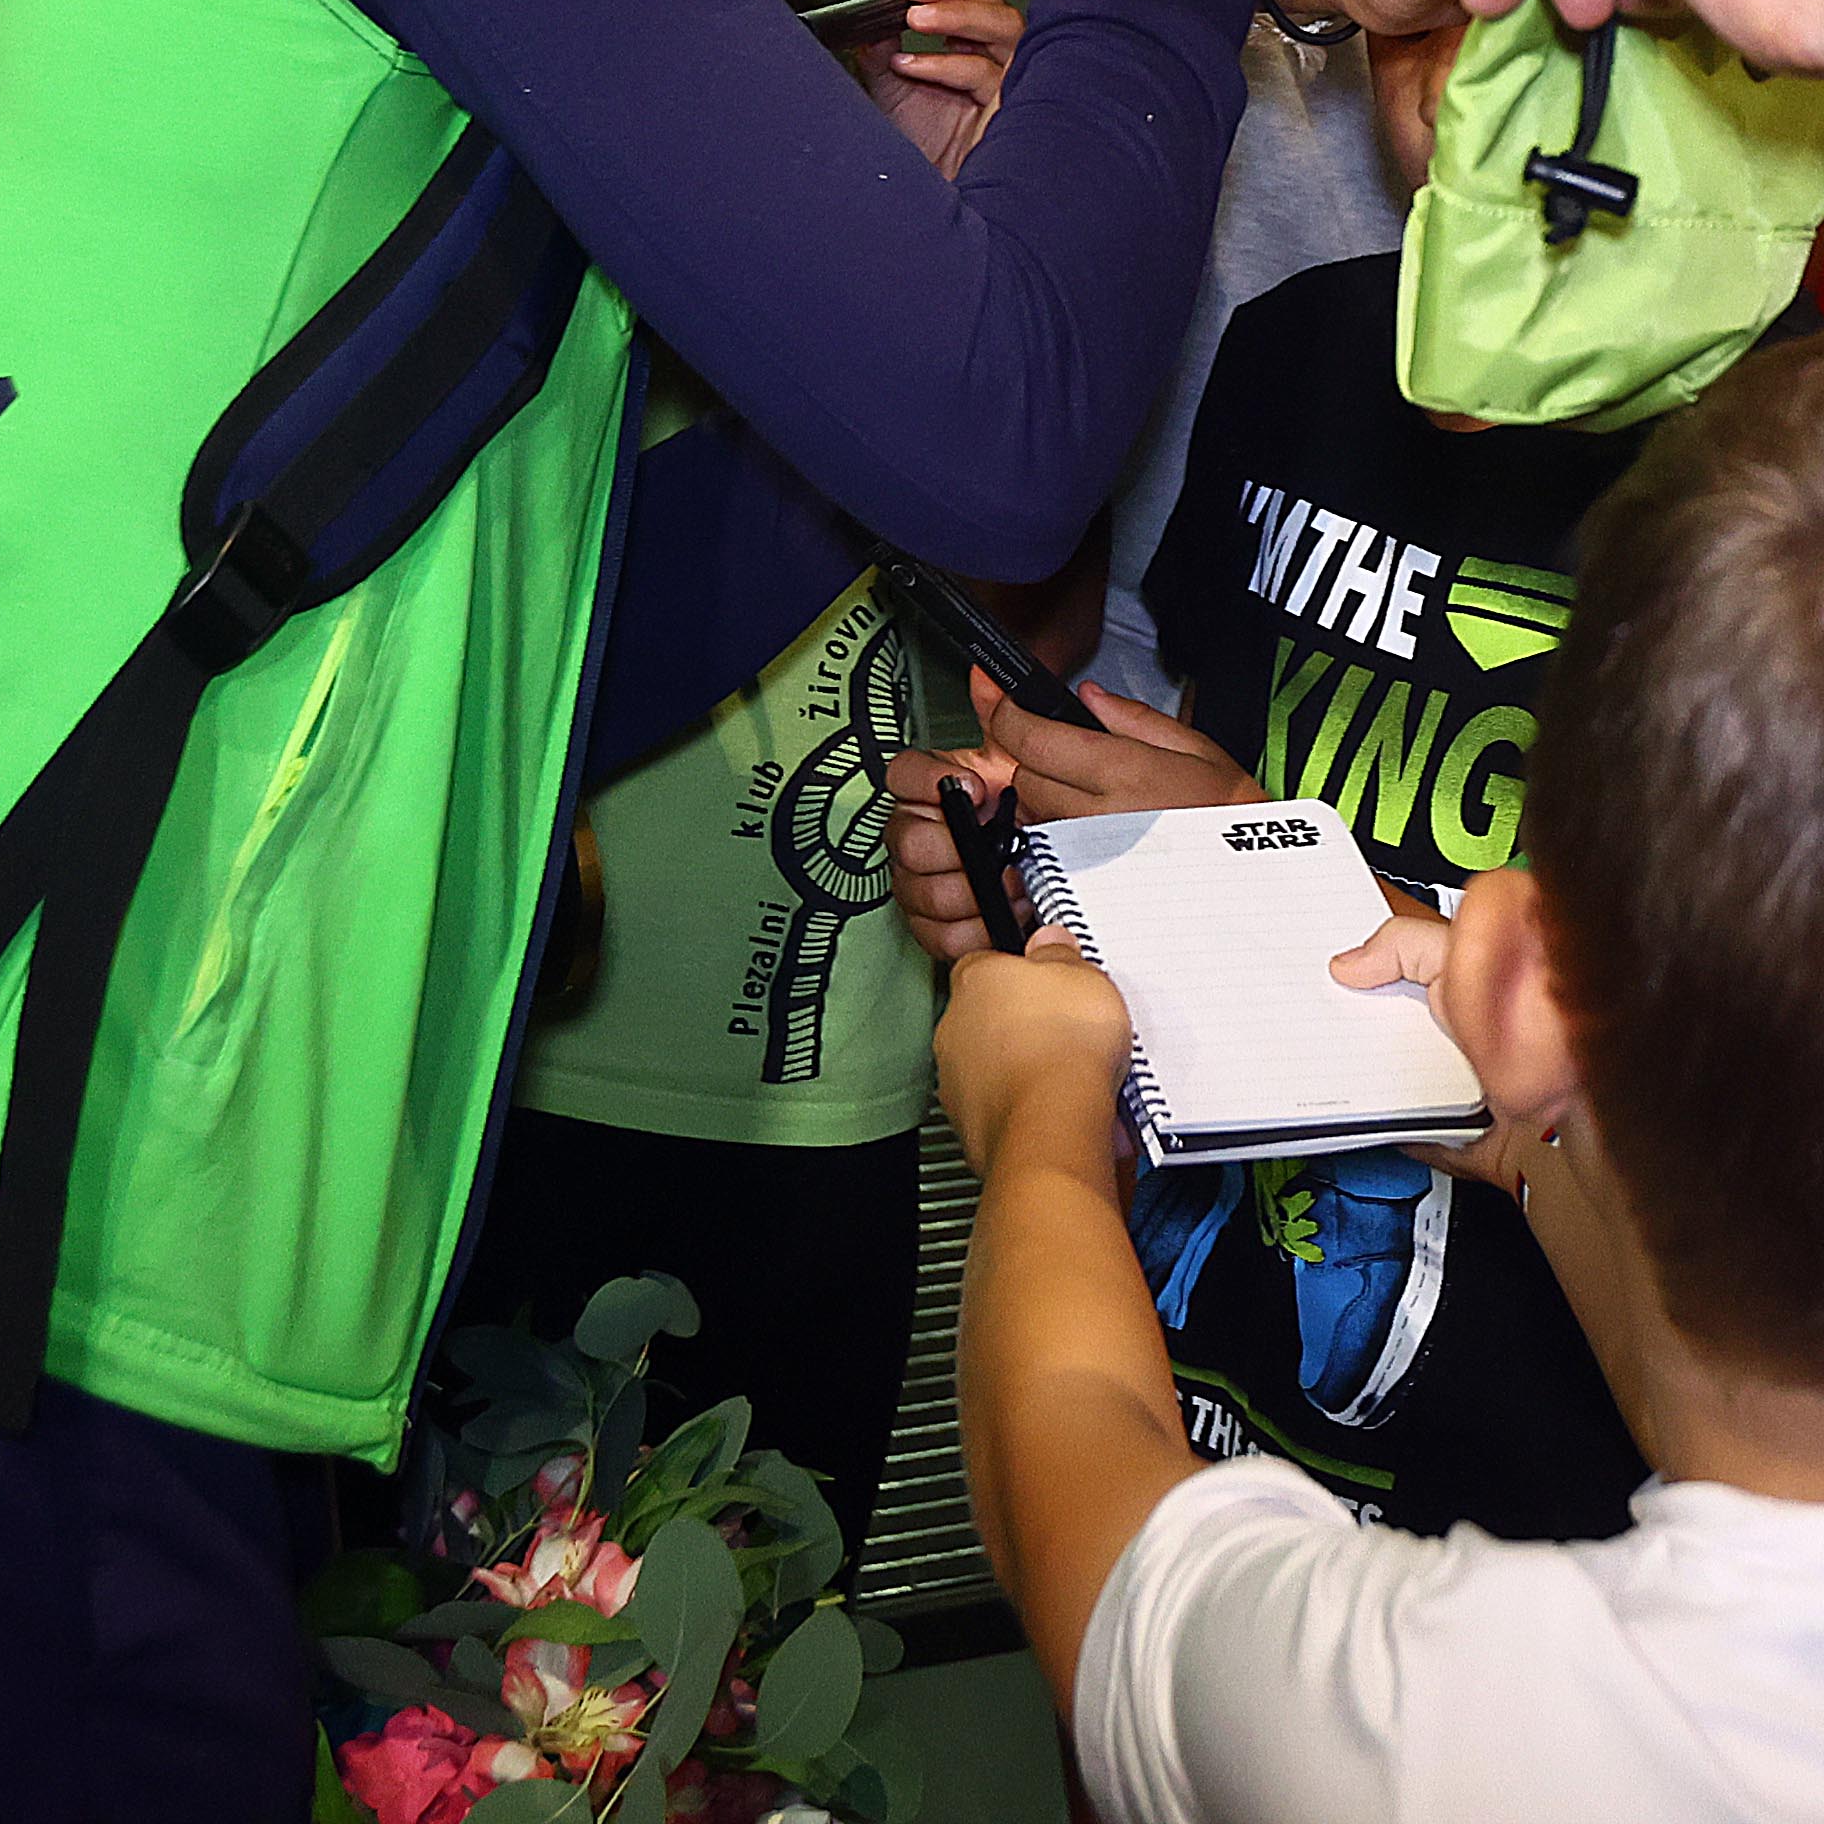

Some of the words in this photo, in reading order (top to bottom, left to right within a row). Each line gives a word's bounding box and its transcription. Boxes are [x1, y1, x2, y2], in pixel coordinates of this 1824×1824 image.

[1256, 636, 1537, 871] KING
[731, 760, 784, 839] klub
[1221, 818, 1318, 838] STAR
[1225, 832, 1322, 852] WARS
[727, 900, 791, 1036] Plezalni
